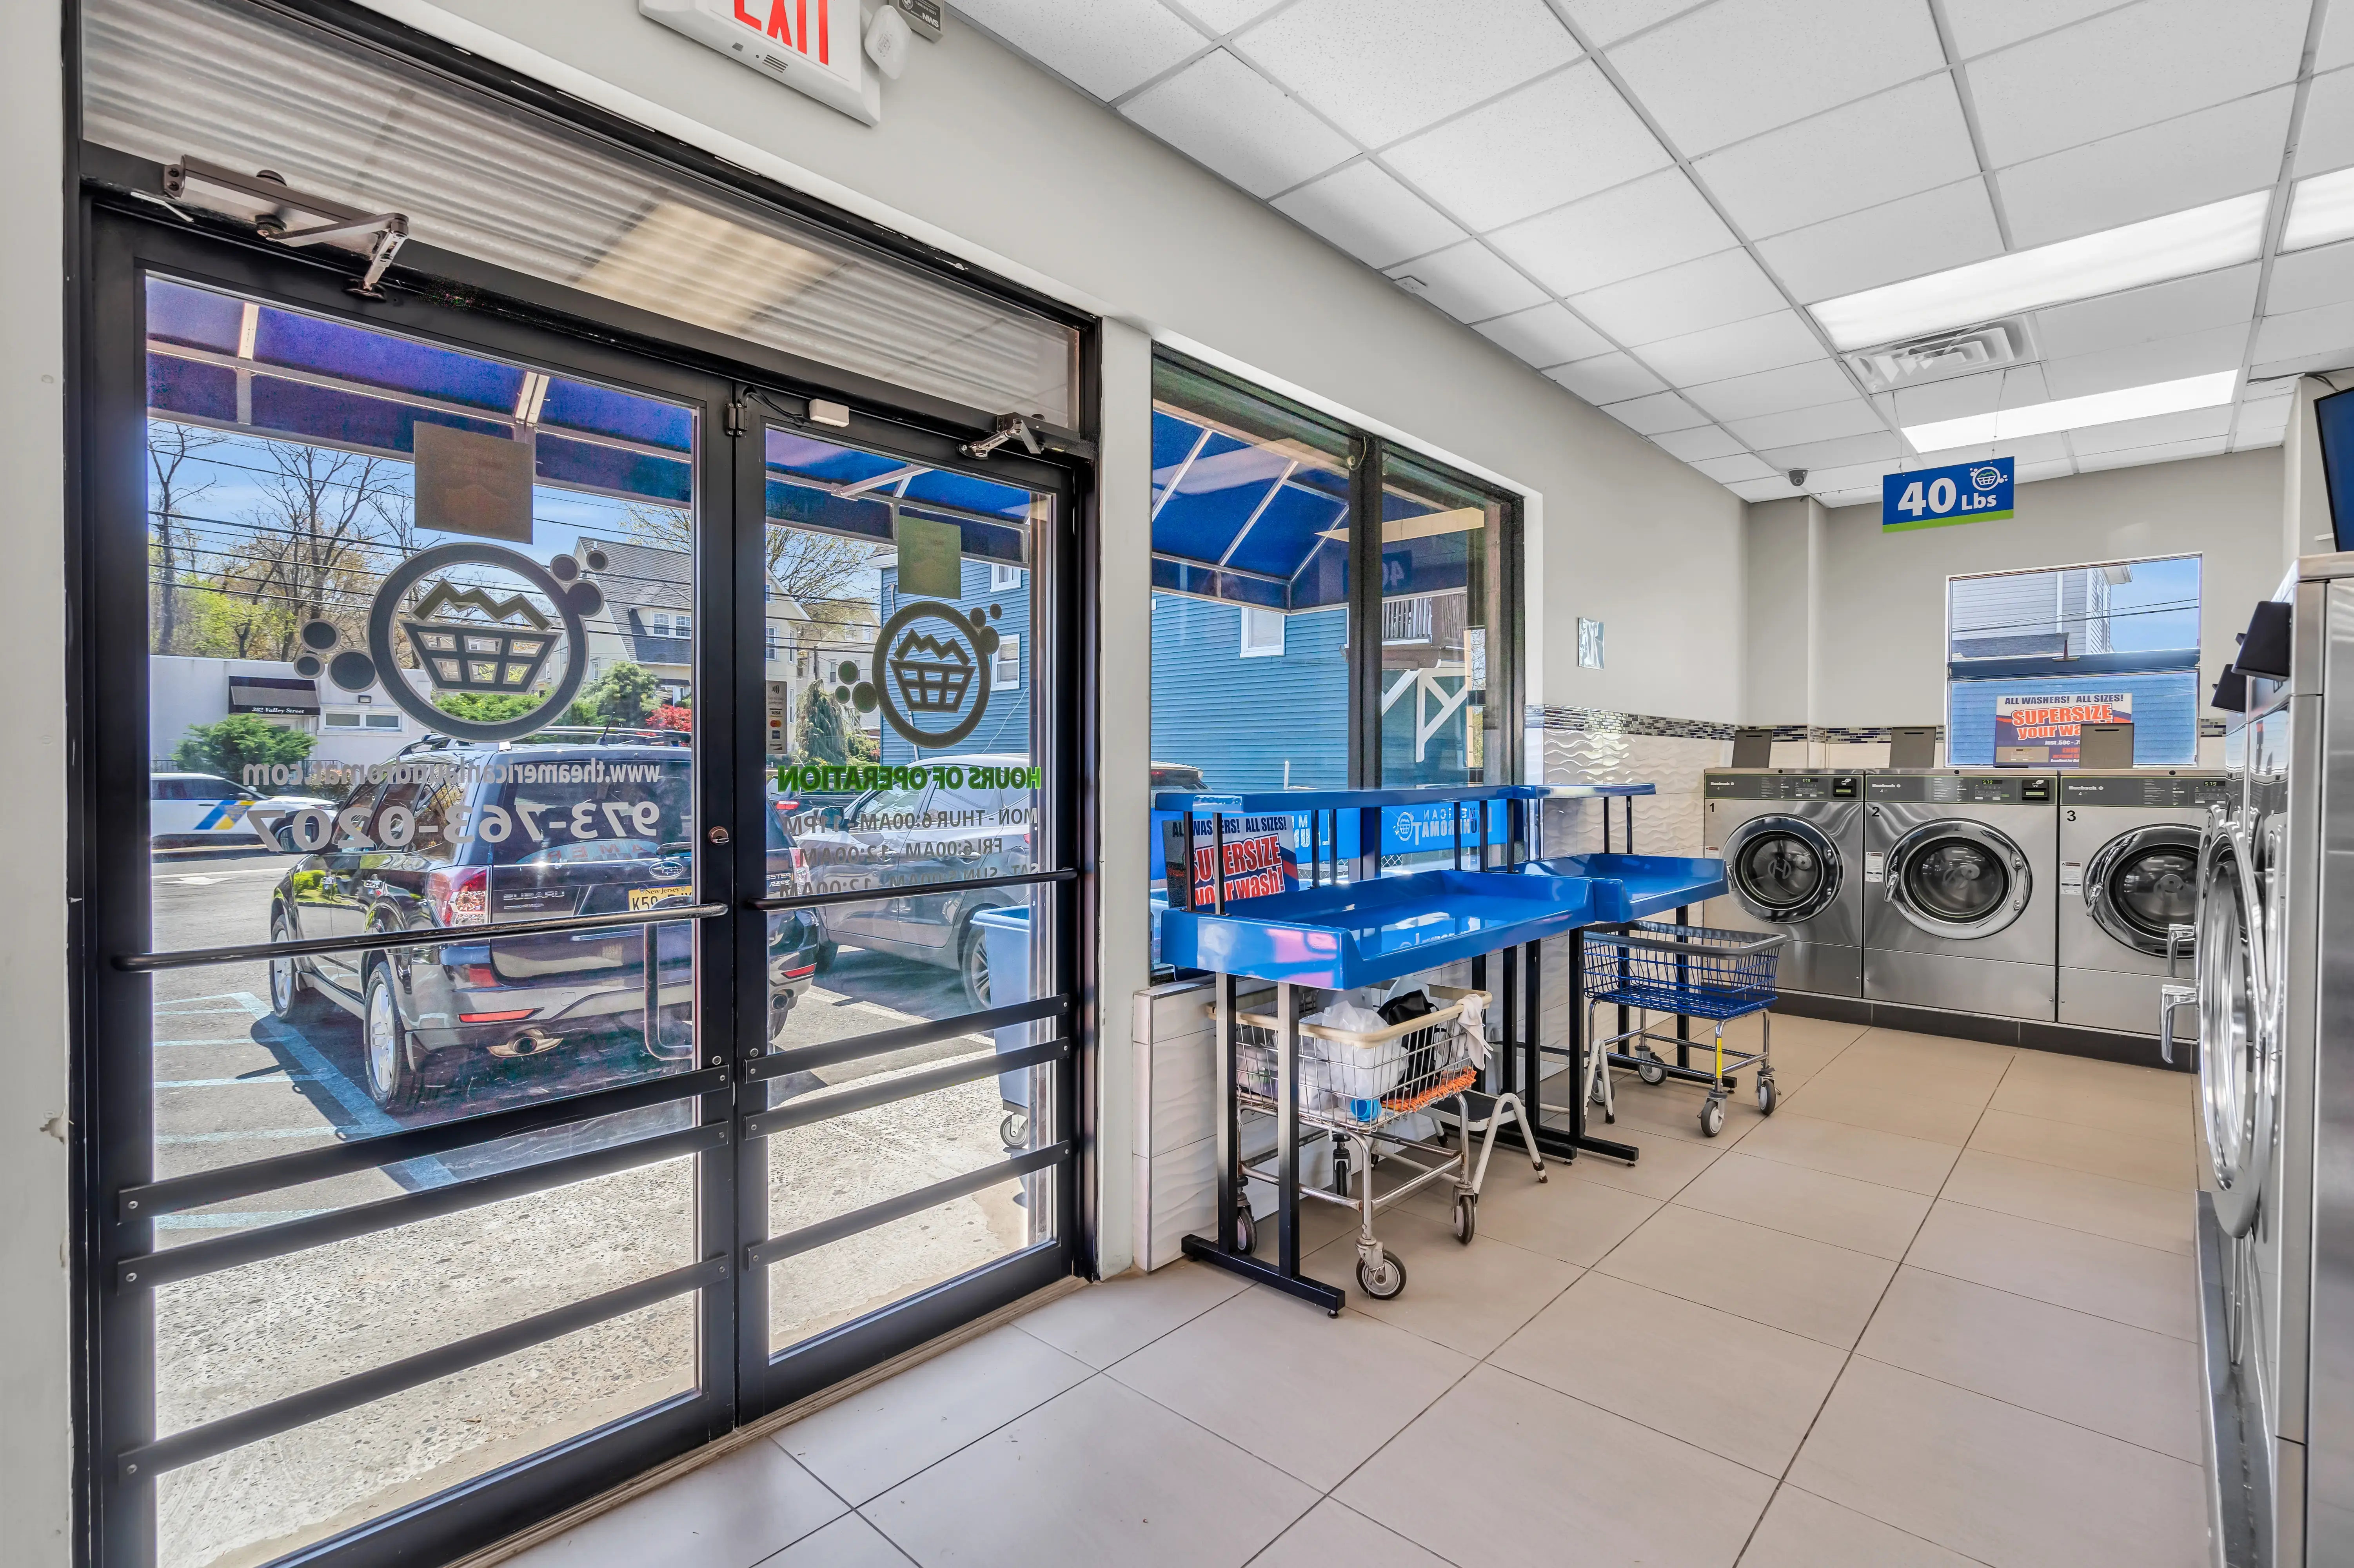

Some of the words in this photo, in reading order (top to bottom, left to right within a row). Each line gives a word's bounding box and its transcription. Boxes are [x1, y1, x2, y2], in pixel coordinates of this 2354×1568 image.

[922, 12, 939, 27] NWS
[1898, 478, 1956, 516] 40
[1962, 493, 1997, 510] Lbs
[2012, 704, 2112, 726] SUPERSIZE
[2017, 725, 2057, 740] your
[1709, 803, 1715, 812] 1
[1872, 807, 1880, 817] 2
[2067, 810, 2076, 822] 3
[1246, 818, 1260, 832] ALL
[1262, 817, 1287, 831] SIZES!
[1235, 866, 1285, 899] wash!
[503, 891, 565, 900] SUBARU
